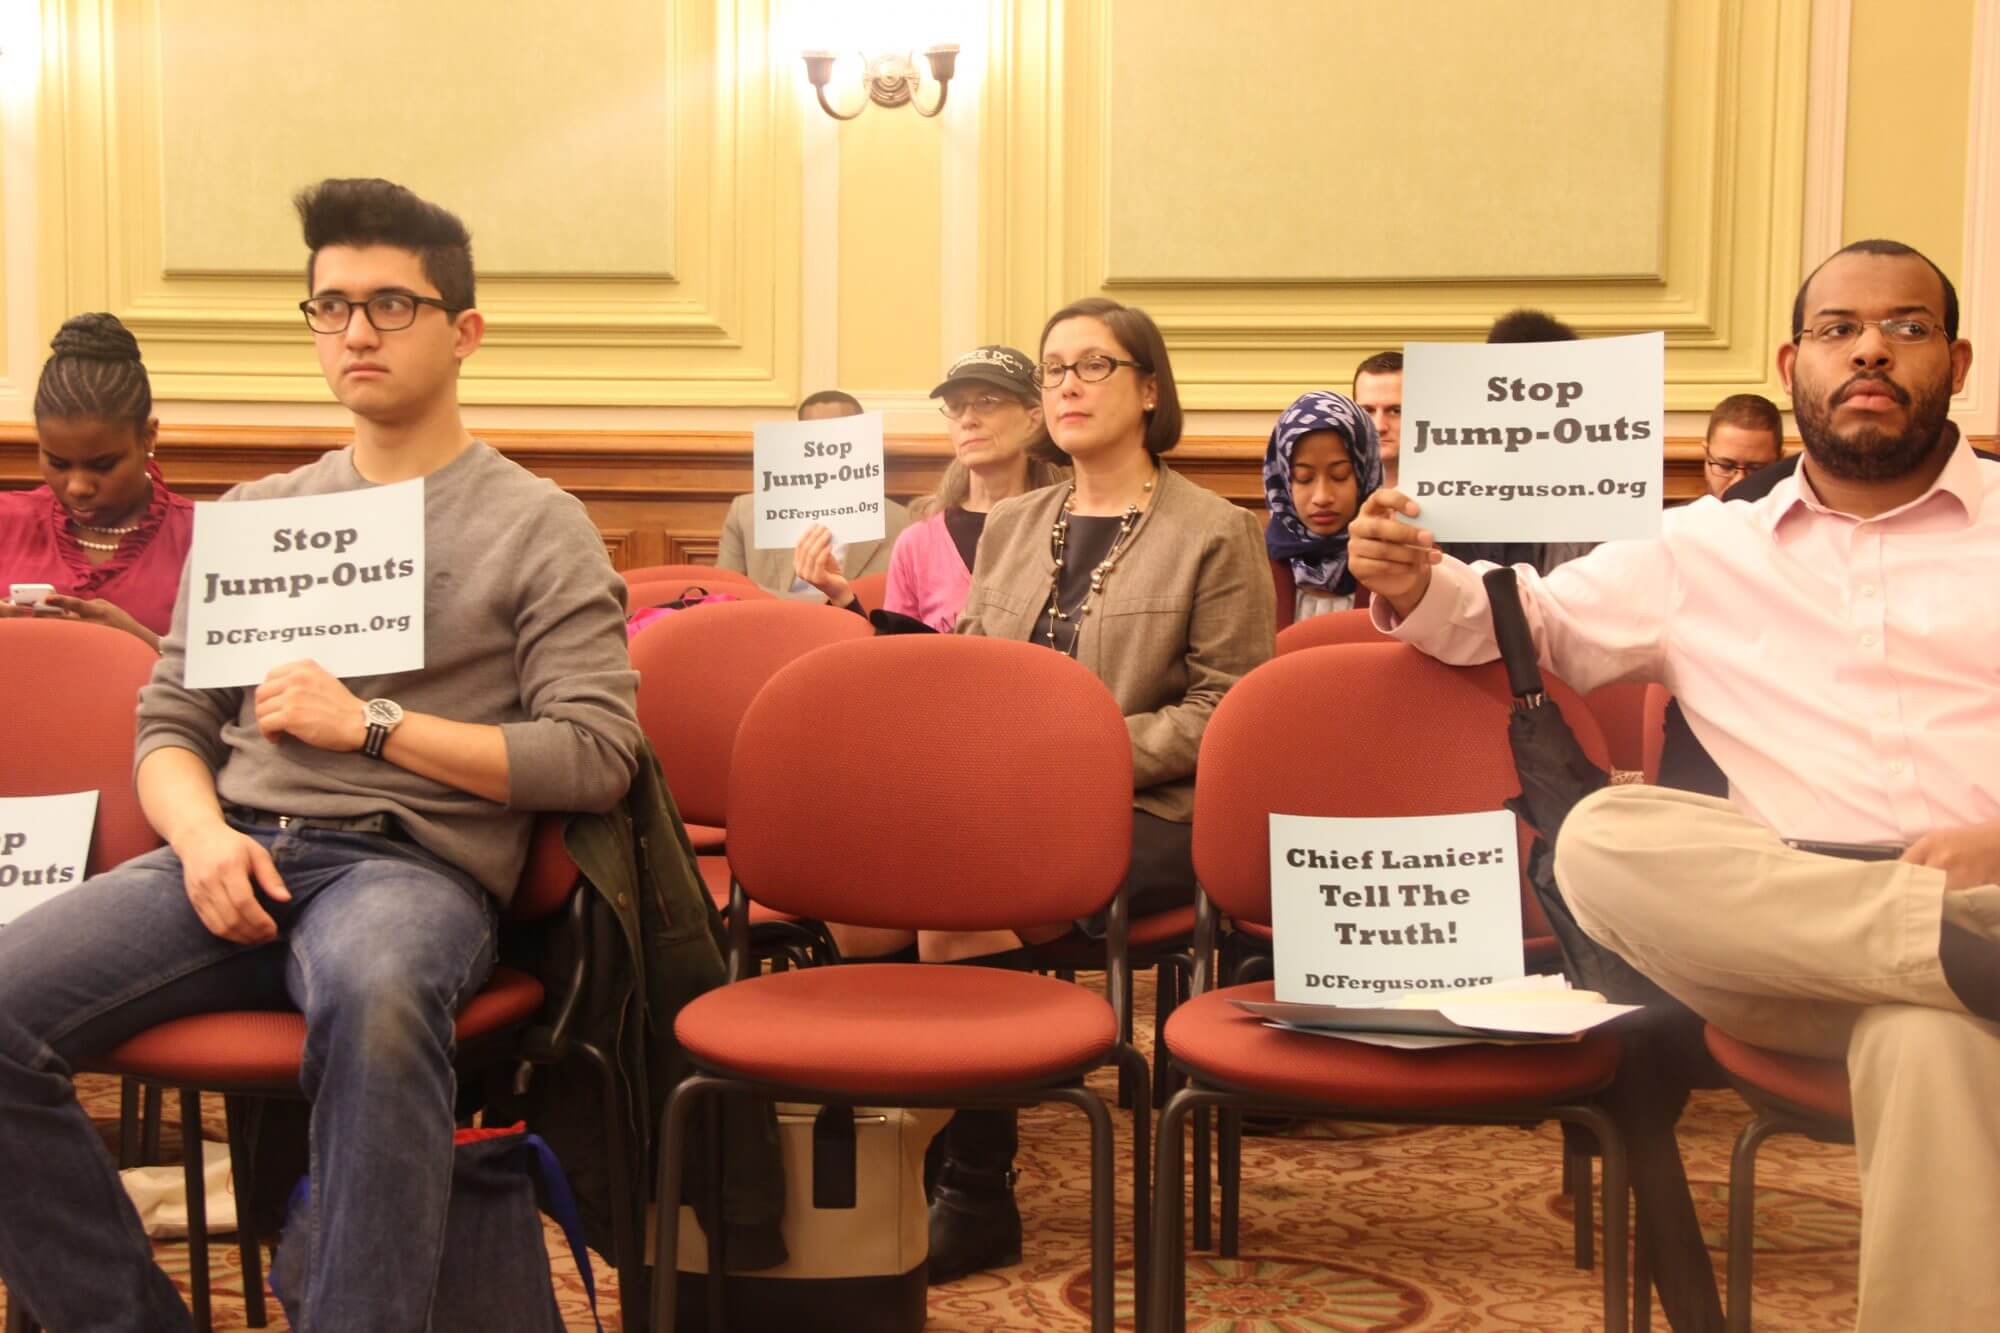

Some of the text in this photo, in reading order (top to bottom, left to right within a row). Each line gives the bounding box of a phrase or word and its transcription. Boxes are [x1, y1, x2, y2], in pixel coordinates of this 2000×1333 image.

[1487, 376, 1583, 408] Stop
[1414, 416, 1651, 453] Jump-Outs
[803, 441, 852, 459] Stop
[762, 462, 880, 491] Jump-Outs
[1417, 478, 1647, 501] DCFerguson.Org
[766, 502, 879, 521] DCFerguson.Org
[273, 528, 358, 553] Stop
[204, 557, 414, 603] Jump-Outs
[206, 615, 411, 645] DCFerguson.Org
[1286, 847, 1504, 870] Chief Lanier:
[1319, 884, 1470, 908] Tell The
[1334, 921, 1457, 946] Truth!
